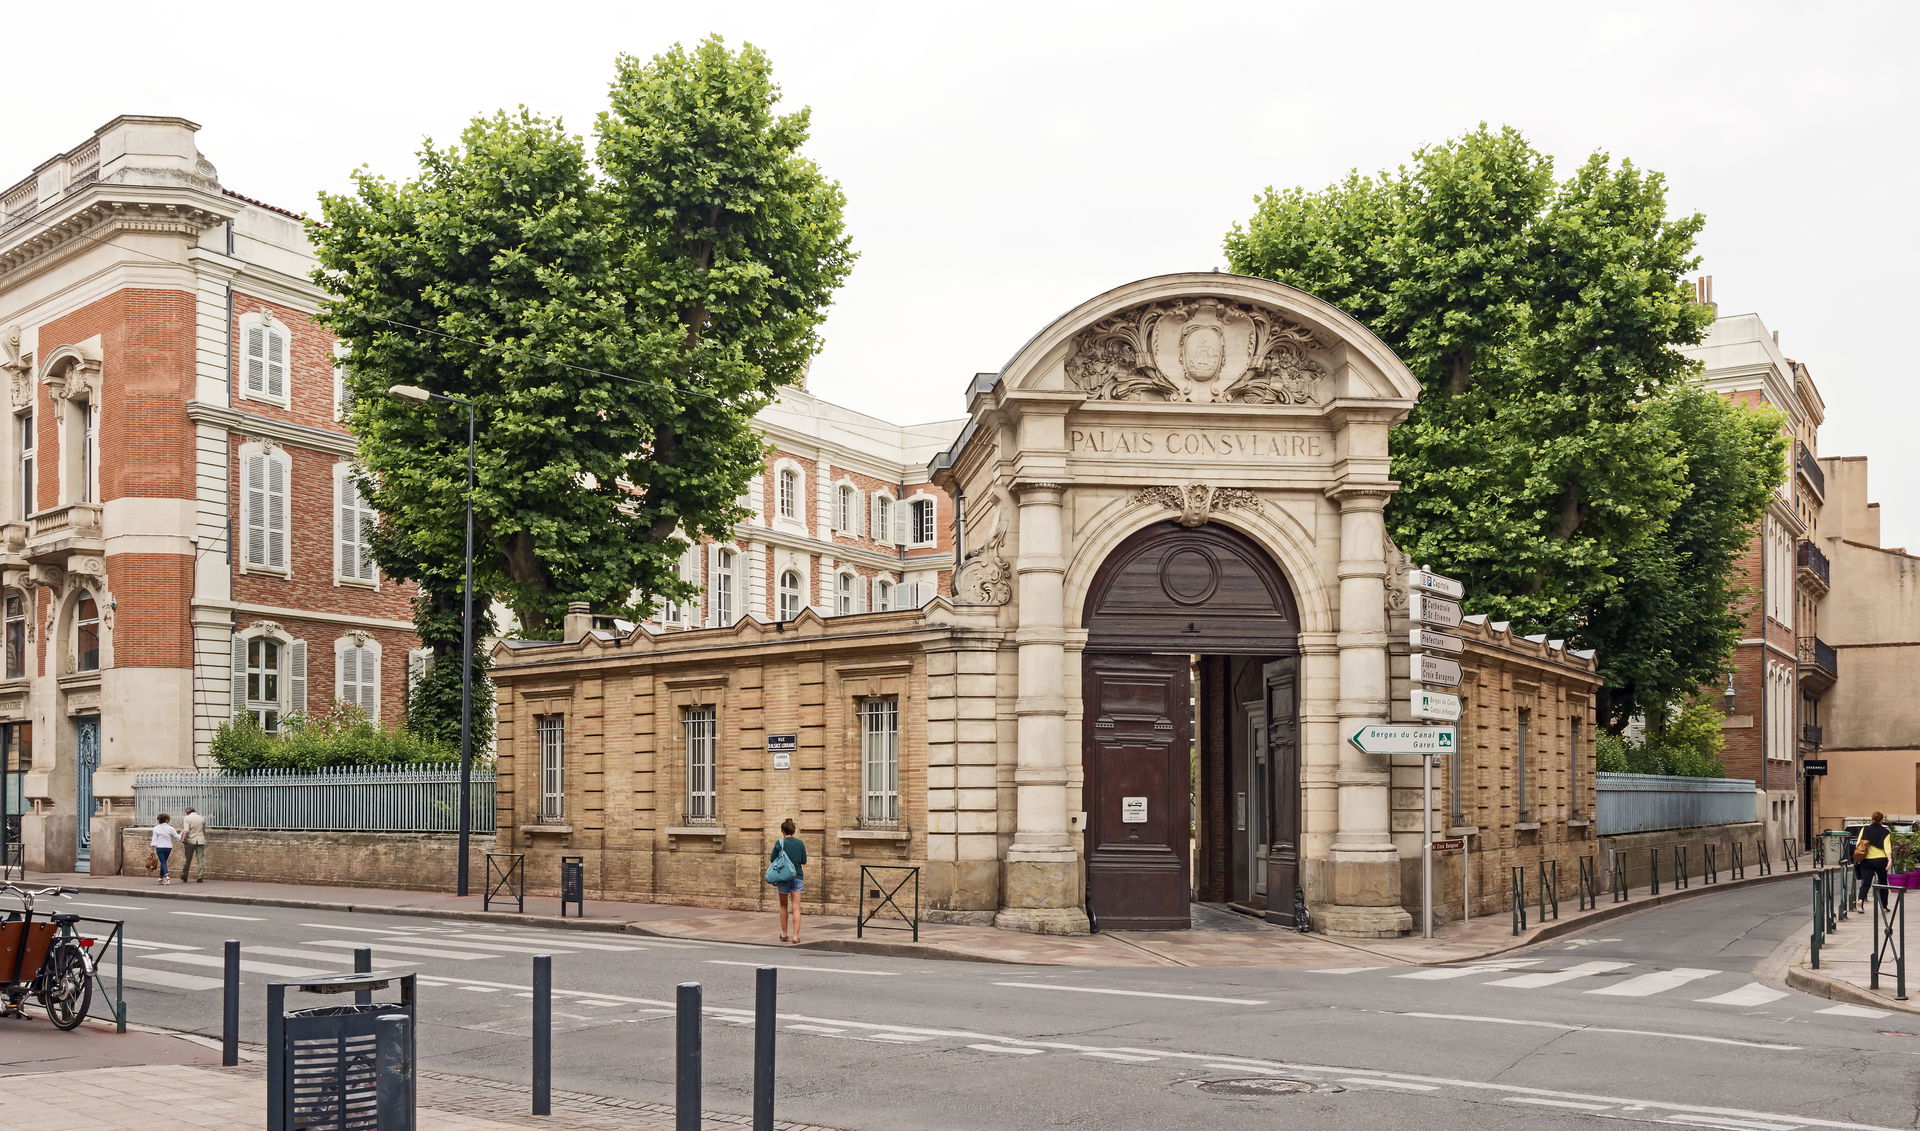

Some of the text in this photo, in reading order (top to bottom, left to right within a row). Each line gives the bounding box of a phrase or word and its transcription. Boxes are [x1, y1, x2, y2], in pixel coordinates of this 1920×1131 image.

[1070, 430, 1322, 456] PALAIS CONSVLAIRE
[1433, 578, 1449, 590] Capitole
[1428, 600, 1450, 612] Cathédrale
[1422, 633, 1444, 645] Préfecture
[1422, 659, 1437, 669] Espace
[1423, 669, 1455, 682] Croix Baragnon
[1371, 731, 1397, 739] Berges
